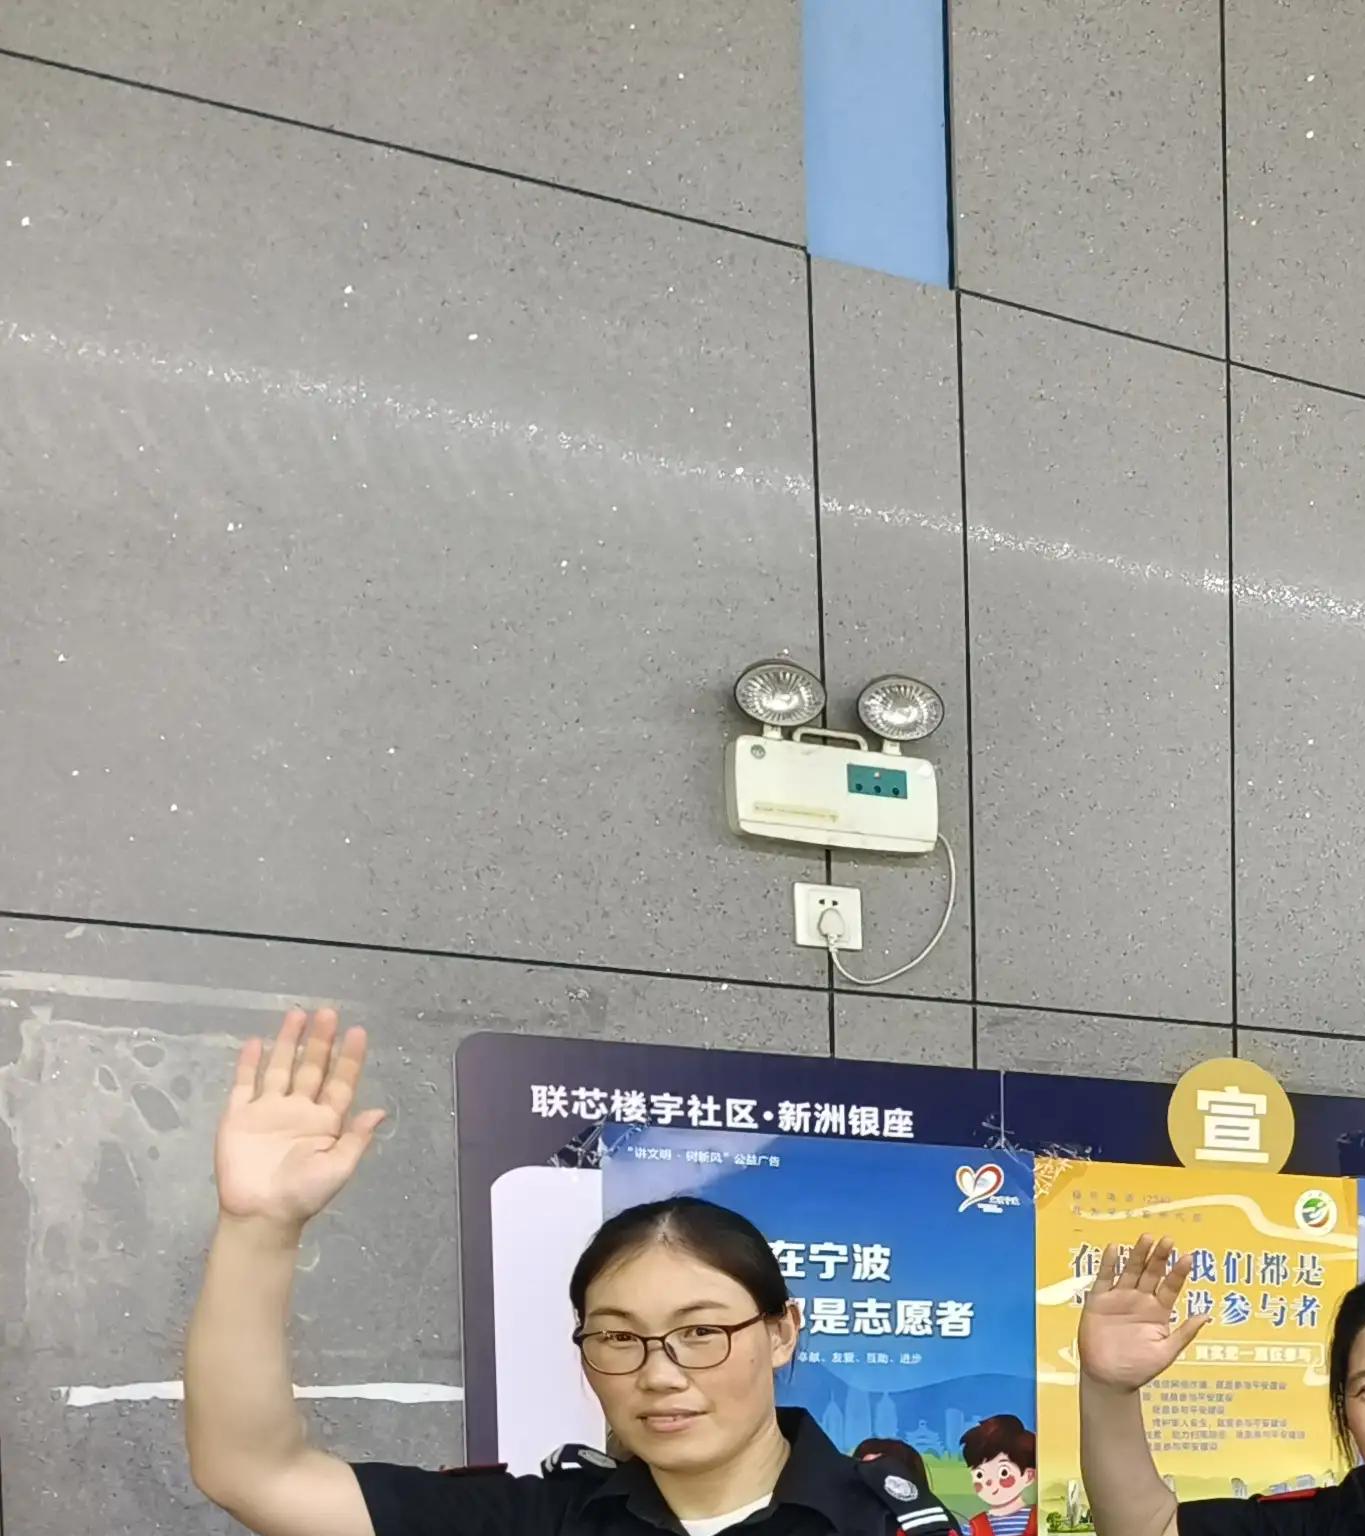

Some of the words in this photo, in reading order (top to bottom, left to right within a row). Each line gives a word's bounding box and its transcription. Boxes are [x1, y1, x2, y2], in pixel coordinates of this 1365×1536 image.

[531, 1085, 914, 1138] 联芯楼宇社区·新洲银座
[1194, 1086, 1270, 1165] 宣
[768, 1239, 892, 1282] 在宁波
